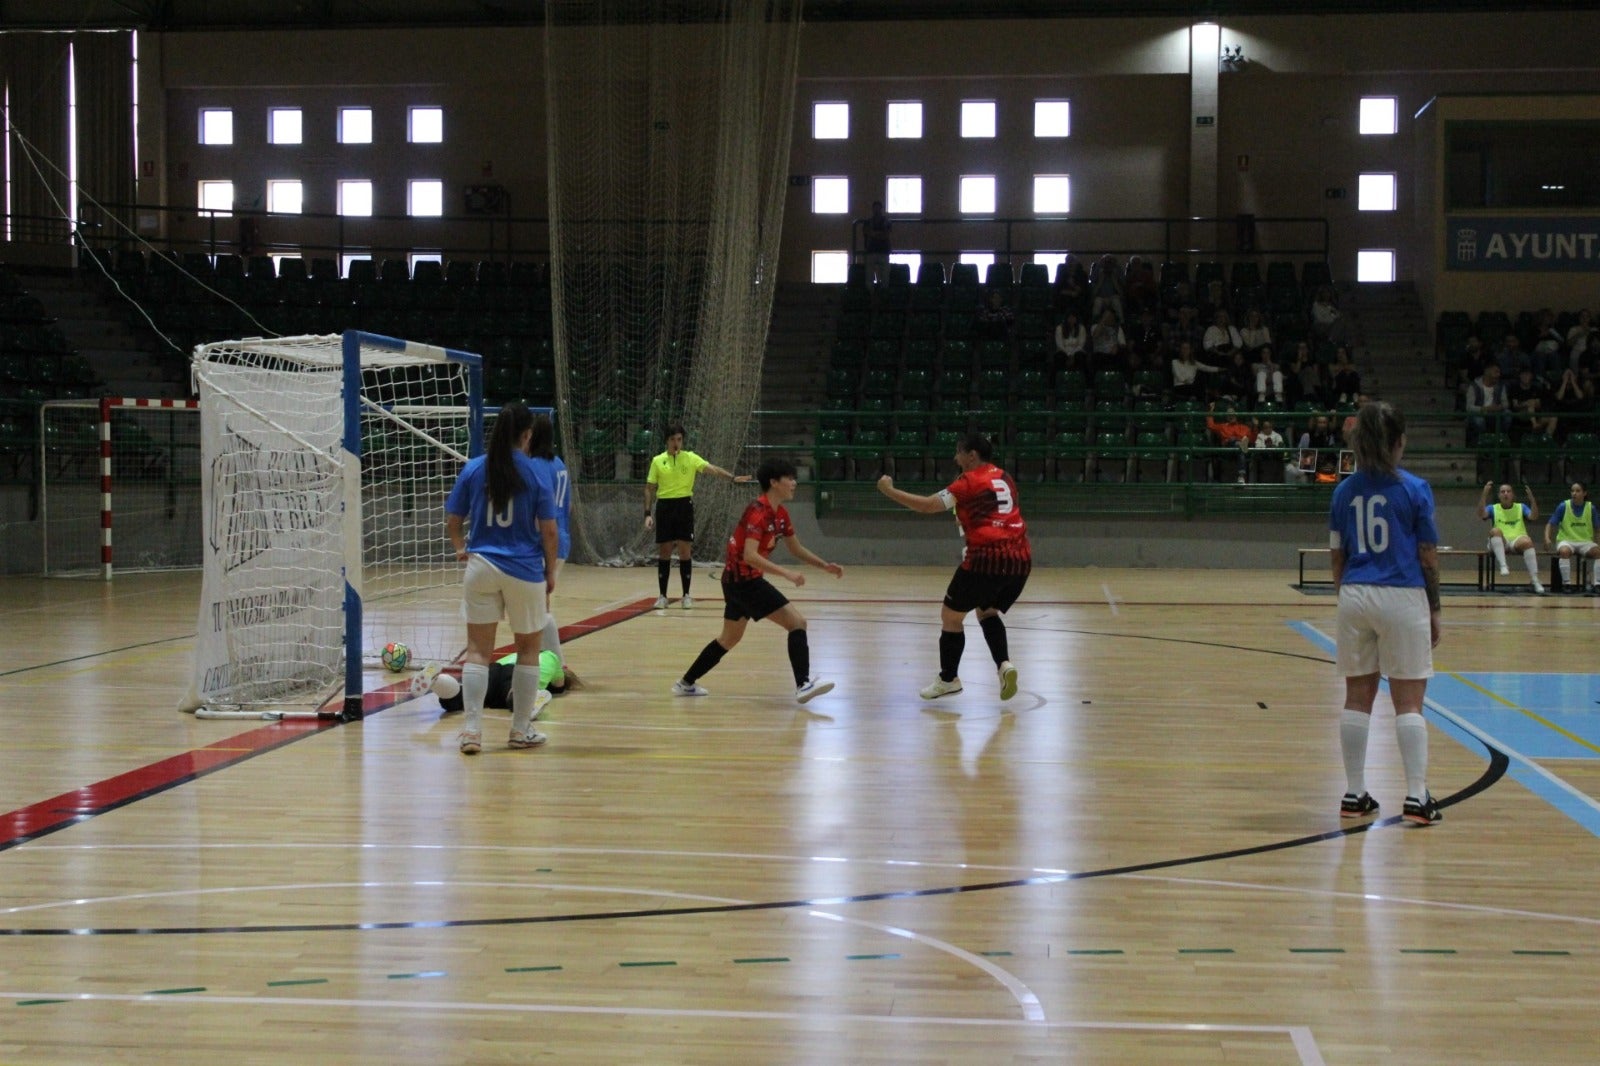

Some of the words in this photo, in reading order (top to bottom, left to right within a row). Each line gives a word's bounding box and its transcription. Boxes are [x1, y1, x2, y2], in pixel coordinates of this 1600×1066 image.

[1485, 232, 1600, 259] AYUNT
[555, 470, 568, 508] 17
[991, 479, 1014, 514] 3
[1349, 494, 1389, 554] 16
